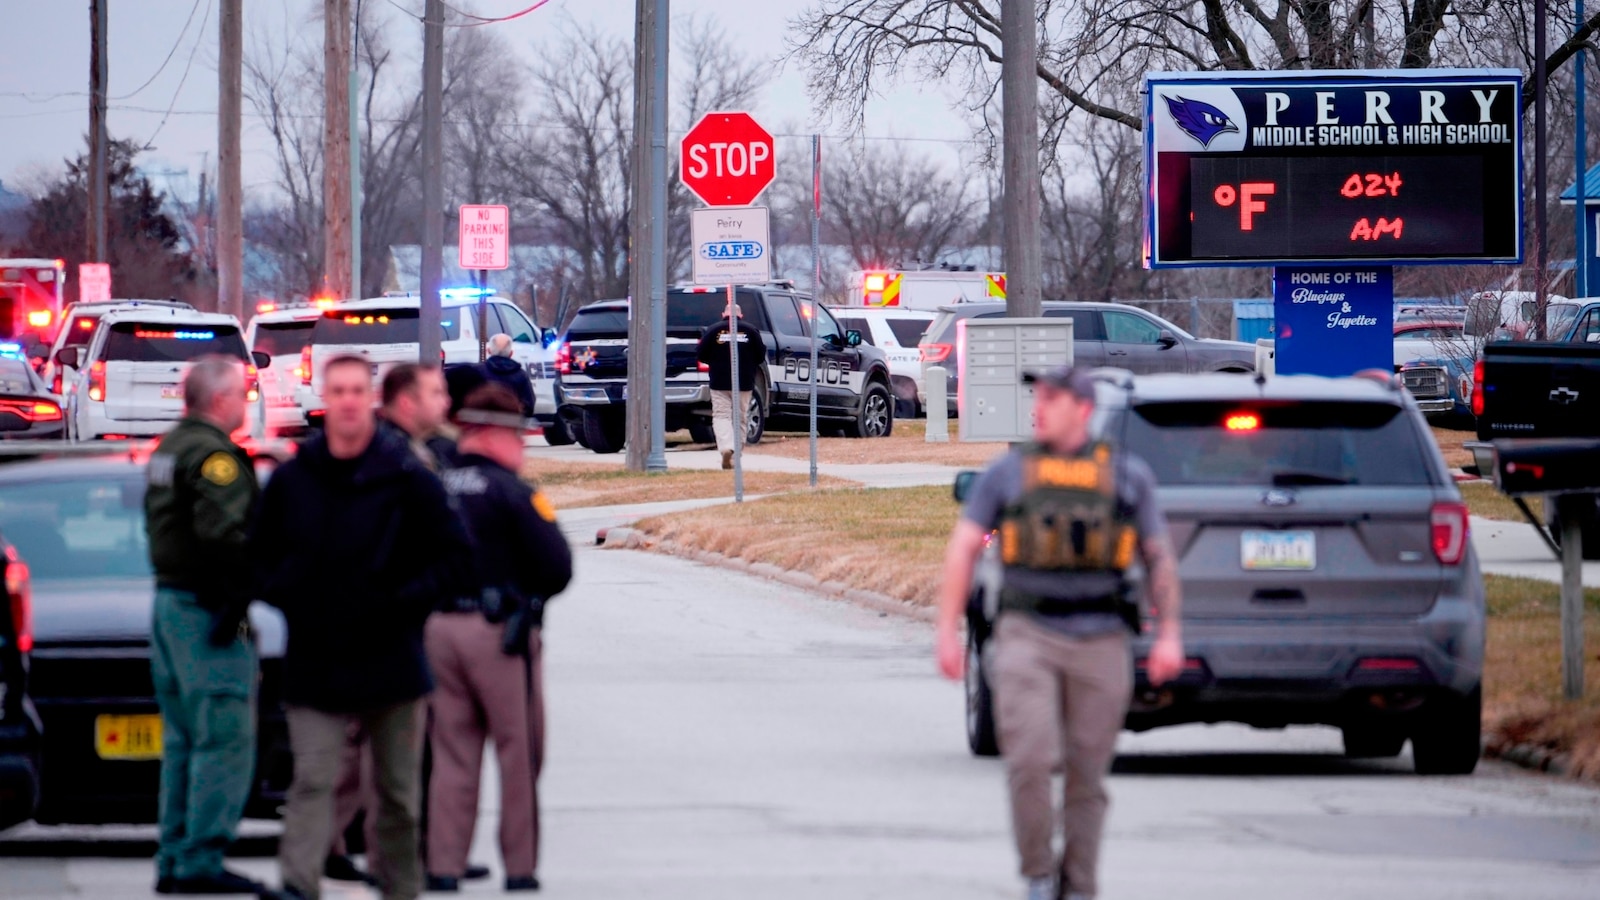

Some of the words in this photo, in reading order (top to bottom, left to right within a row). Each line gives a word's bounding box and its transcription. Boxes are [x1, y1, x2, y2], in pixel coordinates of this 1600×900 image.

[1264, 89, 1499, 126] PERRY
[1252, 126, 1315, 146] MIDDLE
[1318, 125, 1384, 146] SCHOOL
[1387, 126, 1400, 145] &
[1403, 125, 1442, 145] HIGH
[1446, 124, 1512, 144] SCHOOL
[688, 141, 769, 179] STOP
[1341, 172, 1403, 198] 024
[478, 209, 490, 221] NO
[1214, 183, 1275, 231] °F
[464, 223, 504, 235] PARKING
[717, 219, 743, 229] Perry
[1350, 217, 1404, 241] AM
[473, 237, 495, 249] THIS
[708, 244, 754, 257] SAFE
[472, 252, 494, 264] SIDE
[1291, 272, 1331, 284] HOME
[1333, 272, 1352, 284] OF
[1355, 271, 1378, 284] THE
[1291, 287, 1346, 305] Bluejays
[1341, 301, 1352, 313] &
[1326, 311, 1377, 329] Jayettes
[784, 357, 851, 385] POICE
